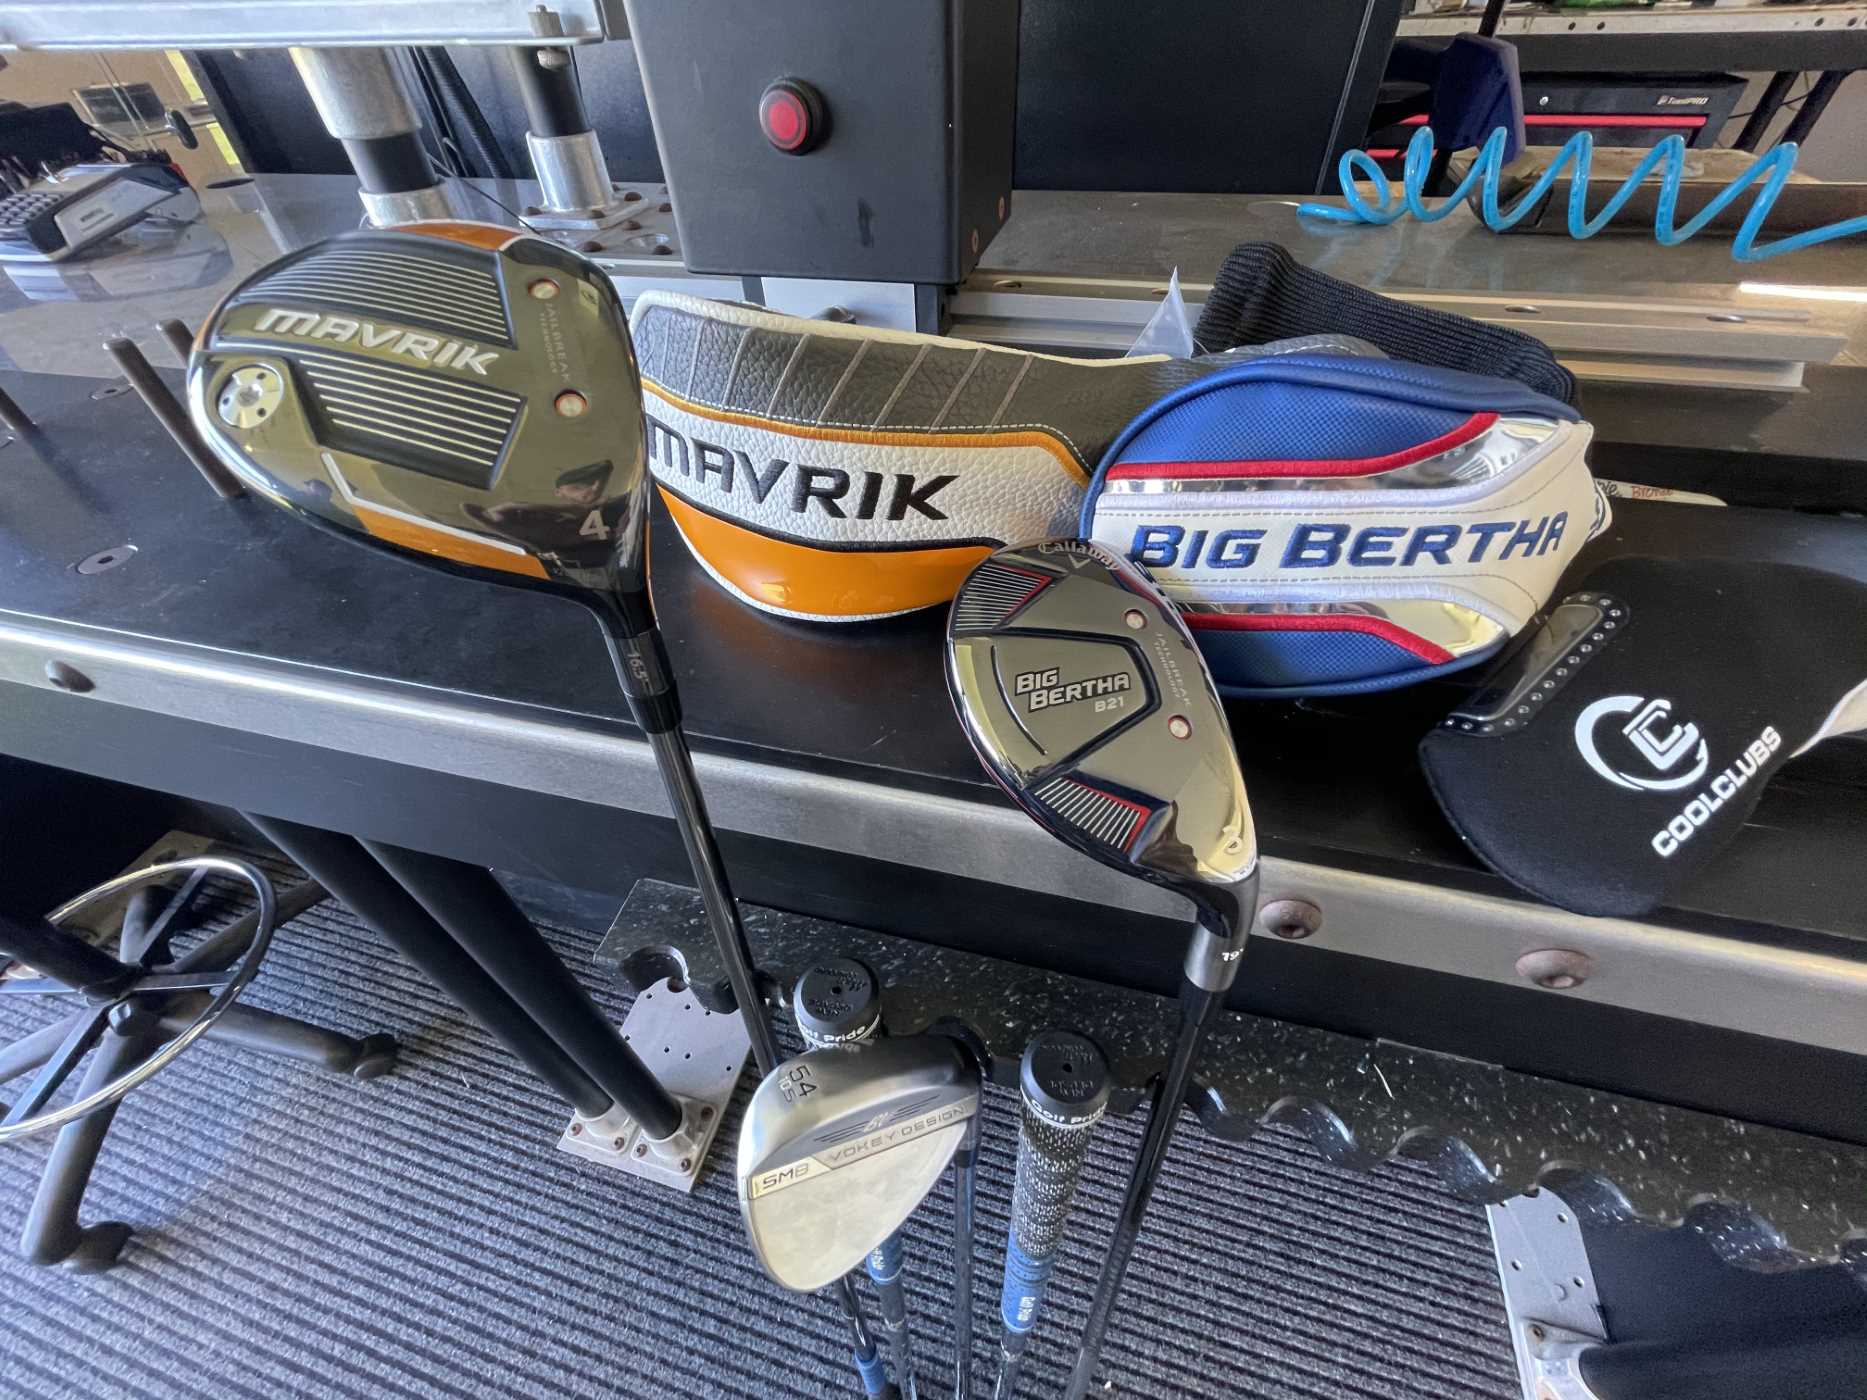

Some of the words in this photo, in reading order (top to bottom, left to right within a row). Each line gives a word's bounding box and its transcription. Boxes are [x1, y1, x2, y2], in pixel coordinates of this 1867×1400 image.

[253, 308, 500, 377] MAVRIK
[645, 412, 960, 521] MAVRIK
[578, 510, 610, 541] 4
[1129, 524, 1268, 569] BIG
[1278, 511, 1569, 568] BERTHA
[1038, 541, 1121, 571] Callaway
[1016, 668, 1059, 695] BIG
[1030, 673, 1131, 711] BERTHA
[1094, 696, 1124, 713] B21
[1651, 726, 1782, 857] COOLCLUBS
[823, 1026, 866, 1042] Pride
[790, 1065, 817, 1097] 54
[830, 1131, 899, 1161] VOKEY
[902, 1106, 965, 1137] DESIGN
